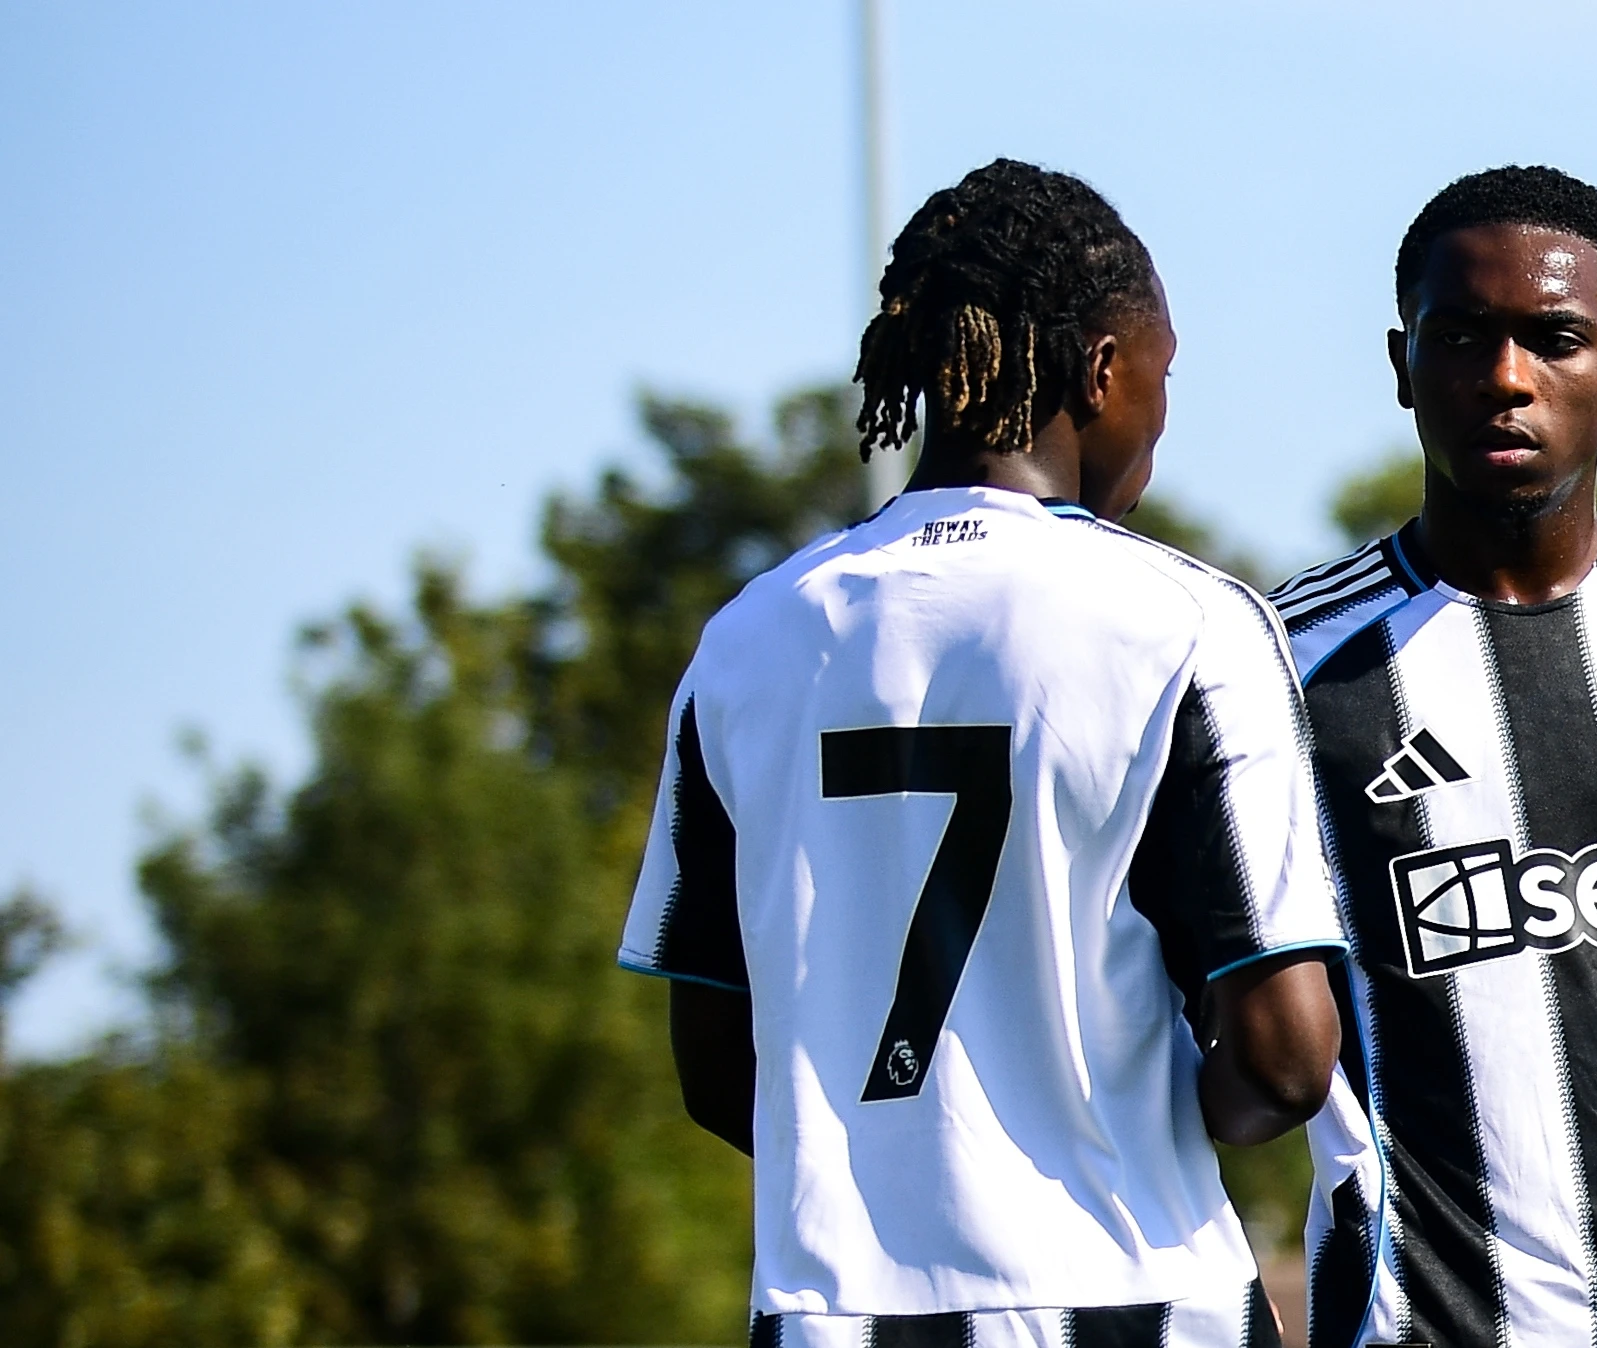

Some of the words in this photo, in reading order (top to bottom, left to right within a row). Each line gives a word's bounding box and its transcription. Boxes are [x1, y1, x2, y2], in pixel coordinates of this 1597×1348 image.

[923, 519, 984, 536] HOWAY
[912, 533, 942, 547] THE
[946, 530, 989, 545] LADS
[820, 724, 1013, 1103] 7
